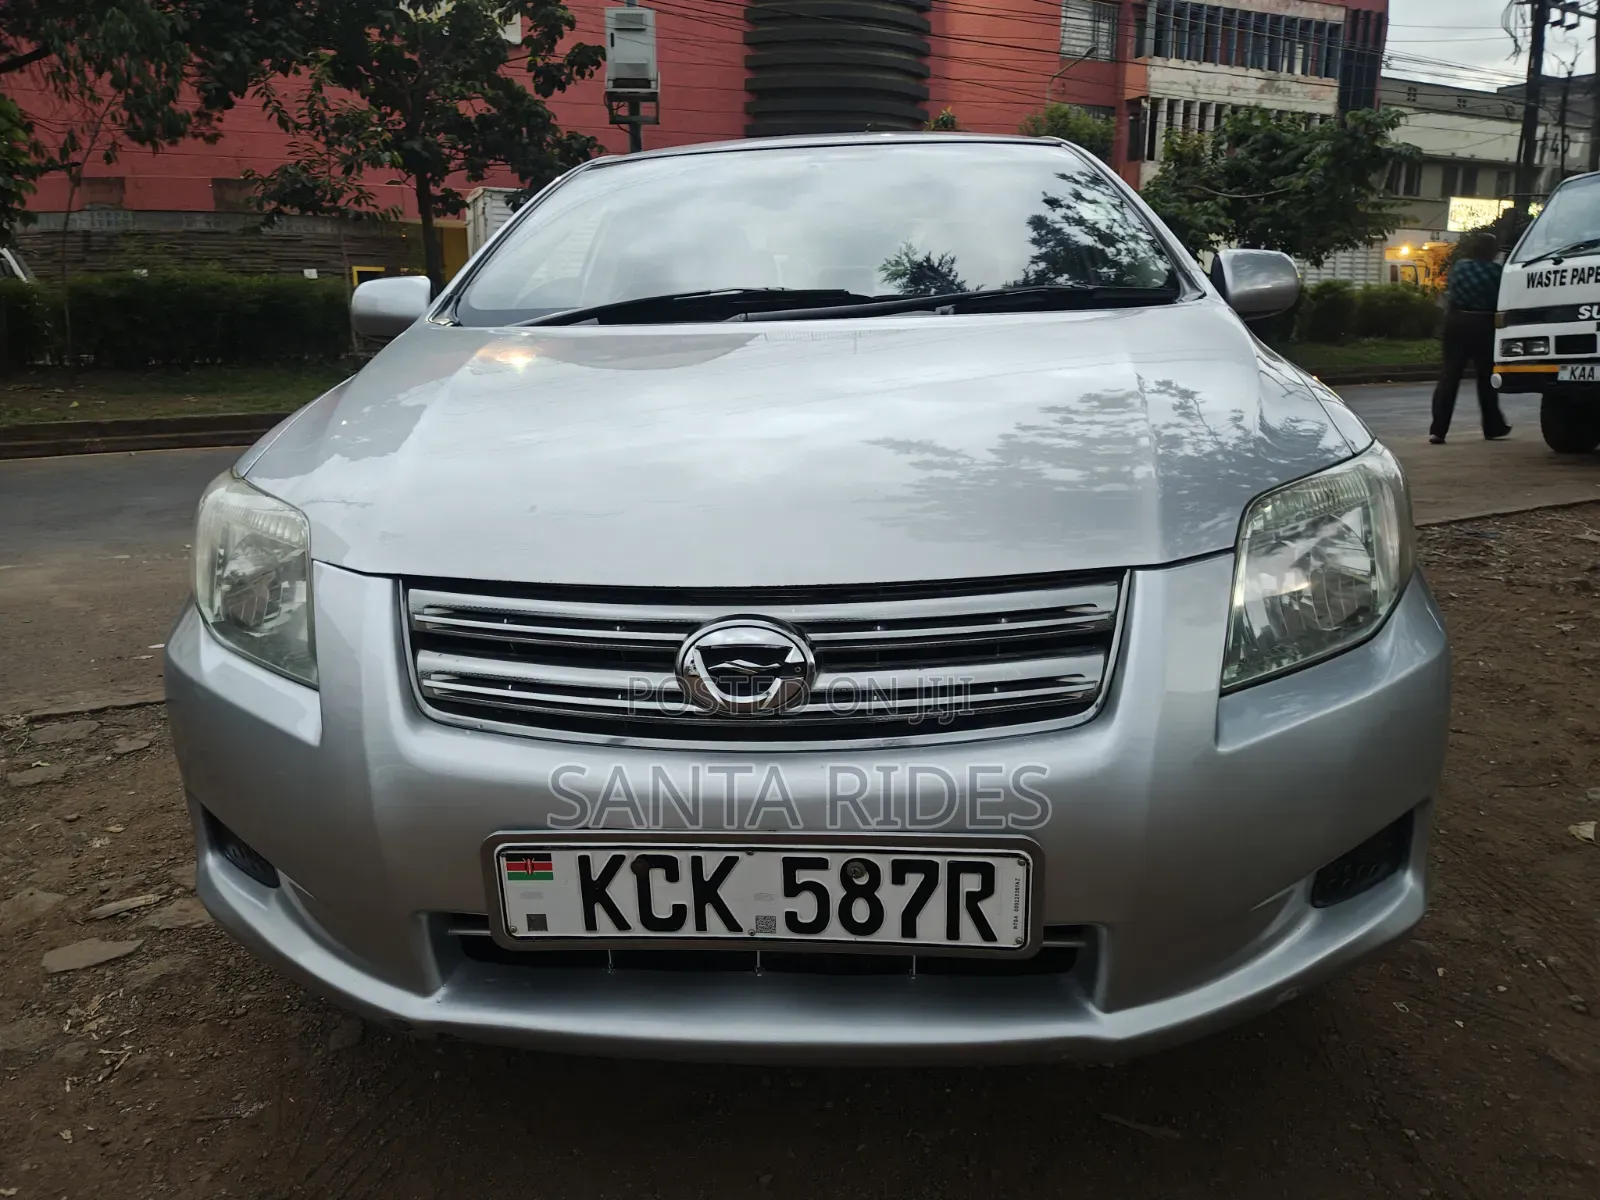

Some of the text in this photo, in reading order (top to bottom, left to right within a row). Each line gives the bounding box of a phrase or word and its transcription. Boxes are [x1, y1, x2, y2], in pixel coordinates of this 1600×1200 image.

[1526, 265, 1600, 288] WASTE PAPE
[1569, 366, 1595, 380] KAA
[577, 853, 998, 942] KCK 587R
